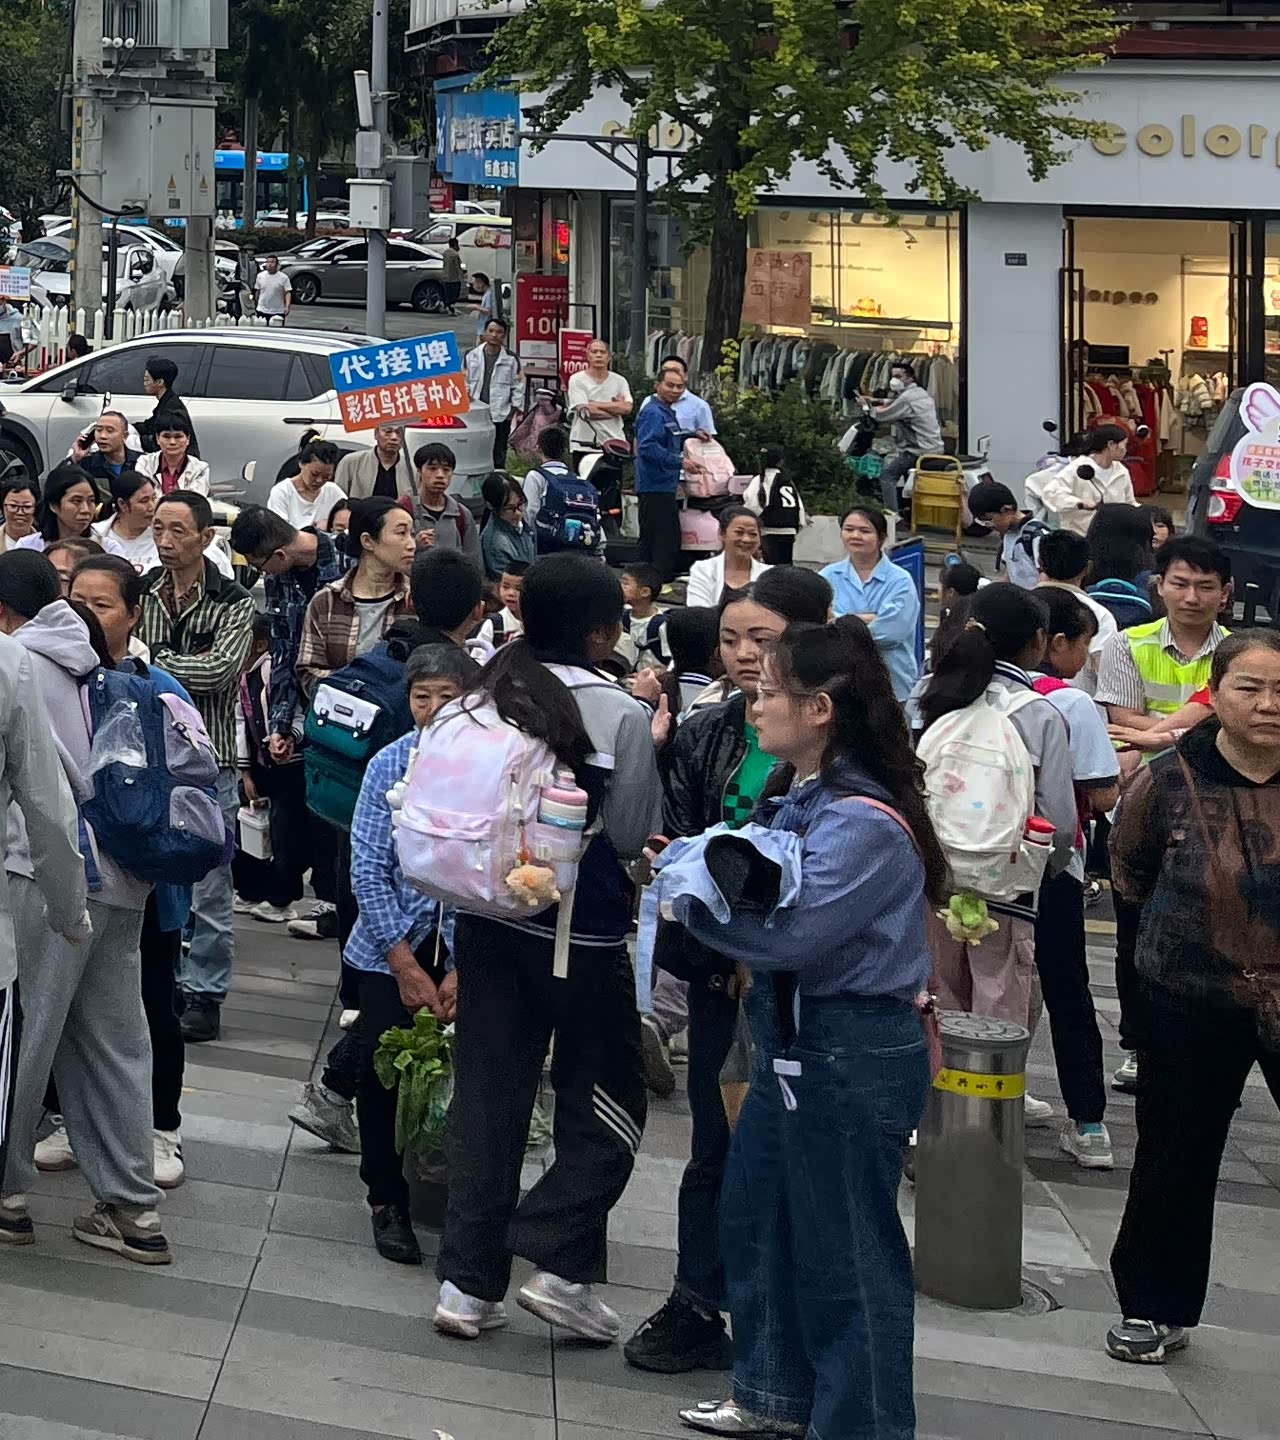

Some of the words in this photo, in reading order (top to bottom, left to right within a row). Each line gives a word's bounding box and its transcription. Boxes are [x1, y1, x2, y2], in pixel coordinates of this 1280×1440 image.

[1091, 114, 1280, 169] color
[526, 316, 568, 336] 100
[338, 339, 453, 385] 代接牌
[344, 378, 463, 424] 彩红鸟托管中心
[779, 485, 797, 508] S
